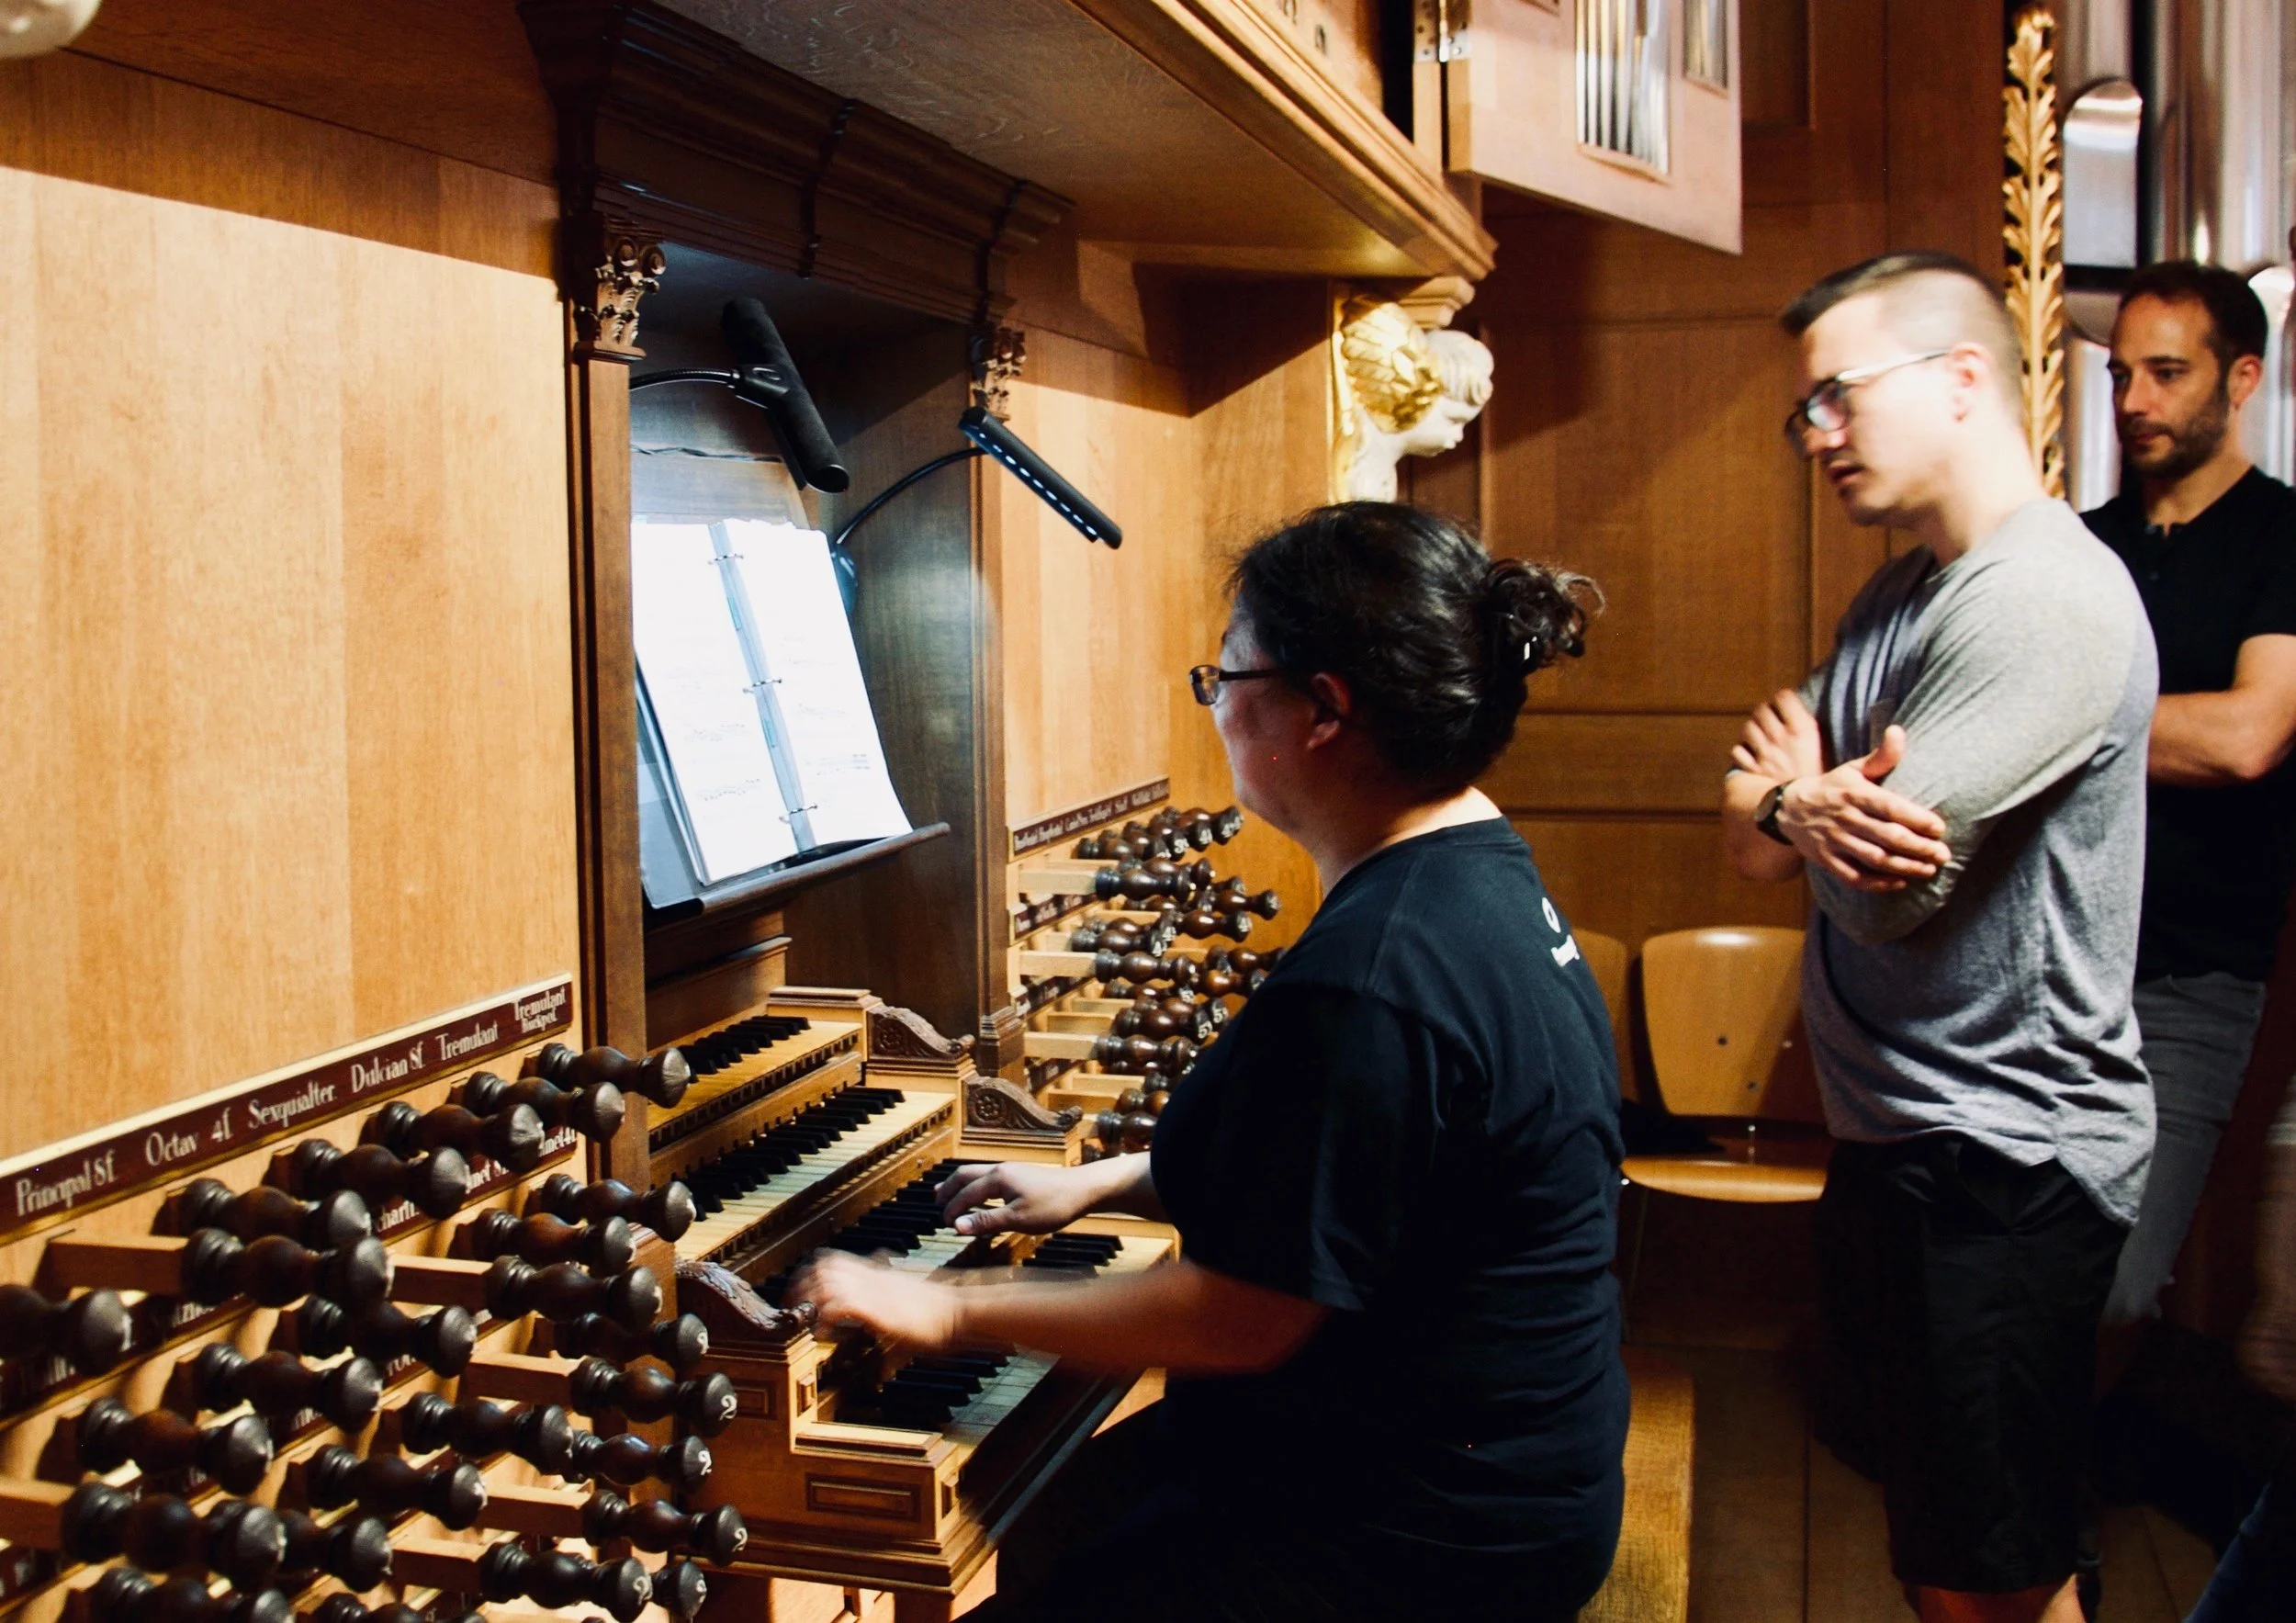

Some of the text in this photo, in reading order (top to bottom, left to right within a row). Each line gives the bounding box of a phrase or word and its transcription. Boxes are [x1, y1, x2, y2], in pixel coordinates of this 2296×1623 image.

[351, 1056, 409, 1094] Dulcian
[435, 1020, 499, 1061] Tremulant
[512, 986, 566, 1020] Tremulant
